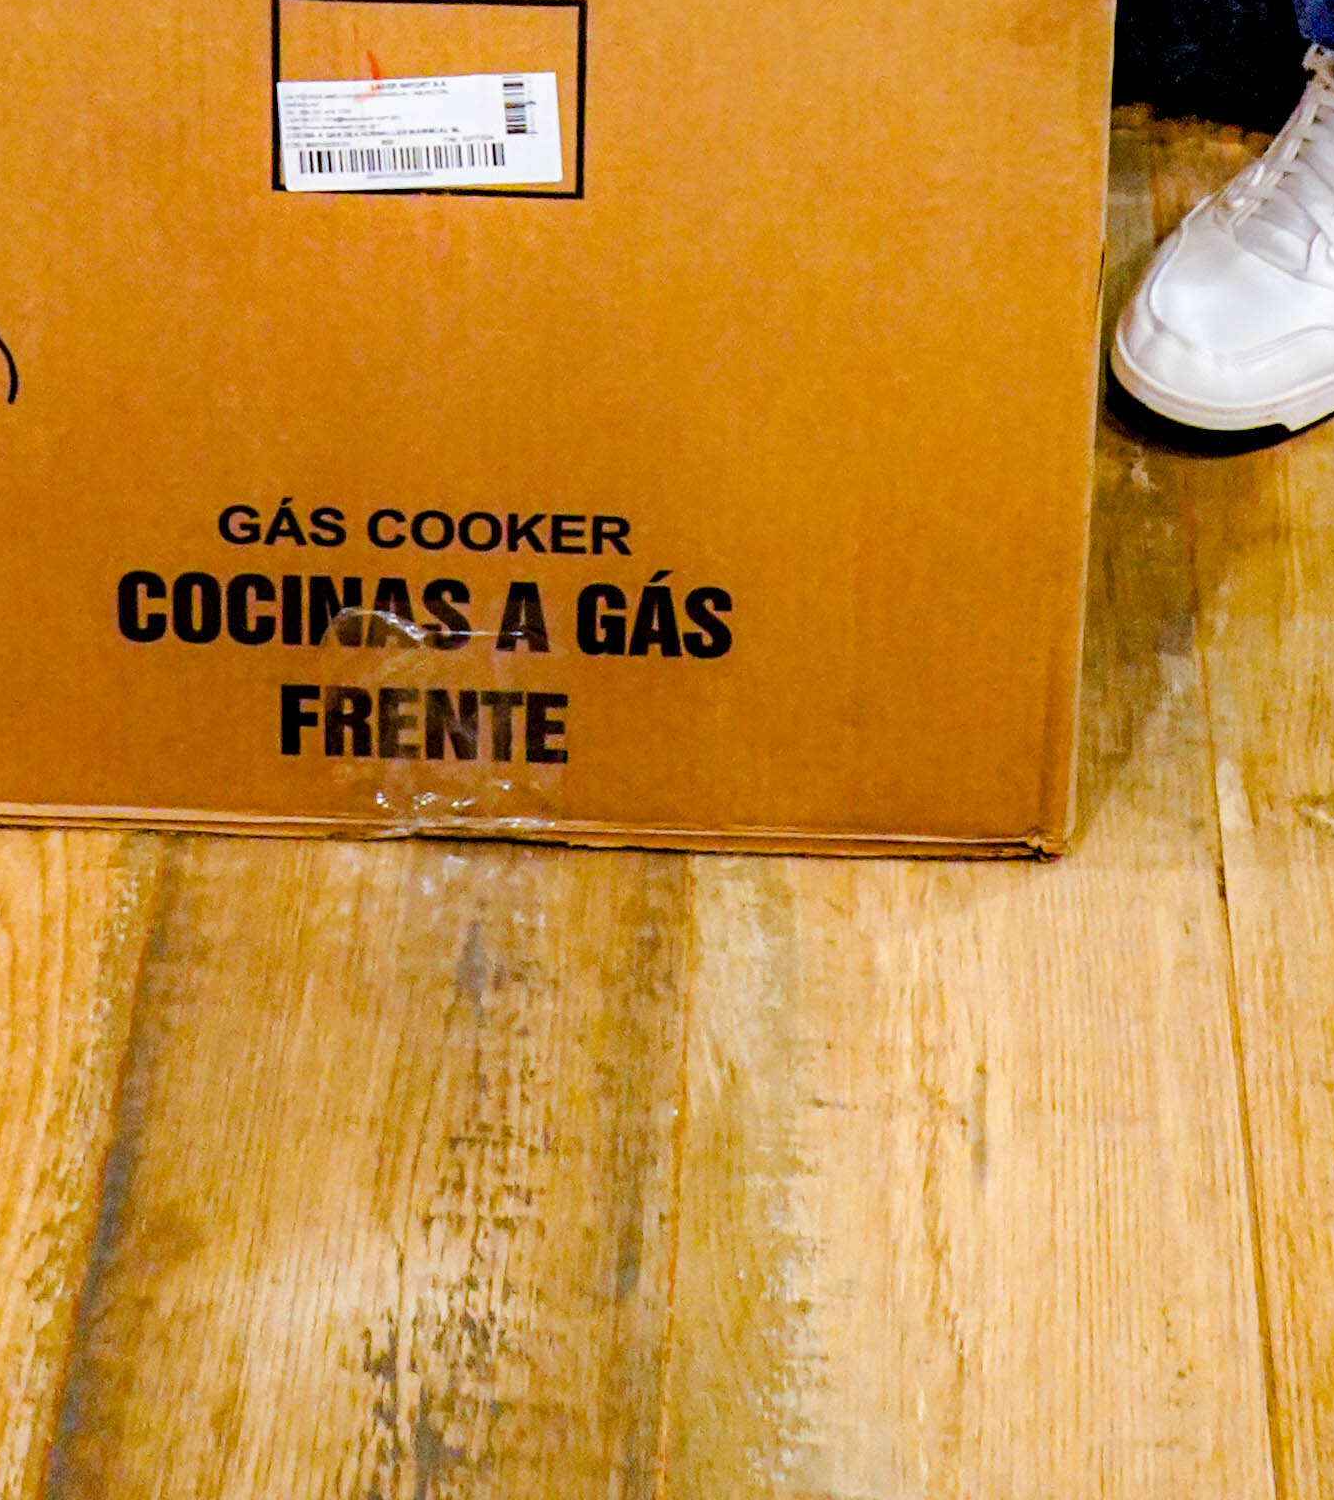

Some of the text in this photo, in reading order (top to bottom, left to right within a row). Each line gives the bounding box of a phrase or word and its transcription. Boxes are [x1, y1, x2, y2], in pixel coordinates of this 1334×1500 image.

[218, 497, 632, 556] GÁS COOKER
[116, 569, 734, 659] COCINAS A GÁS
[279, 683, 569, 764] FRENTE
